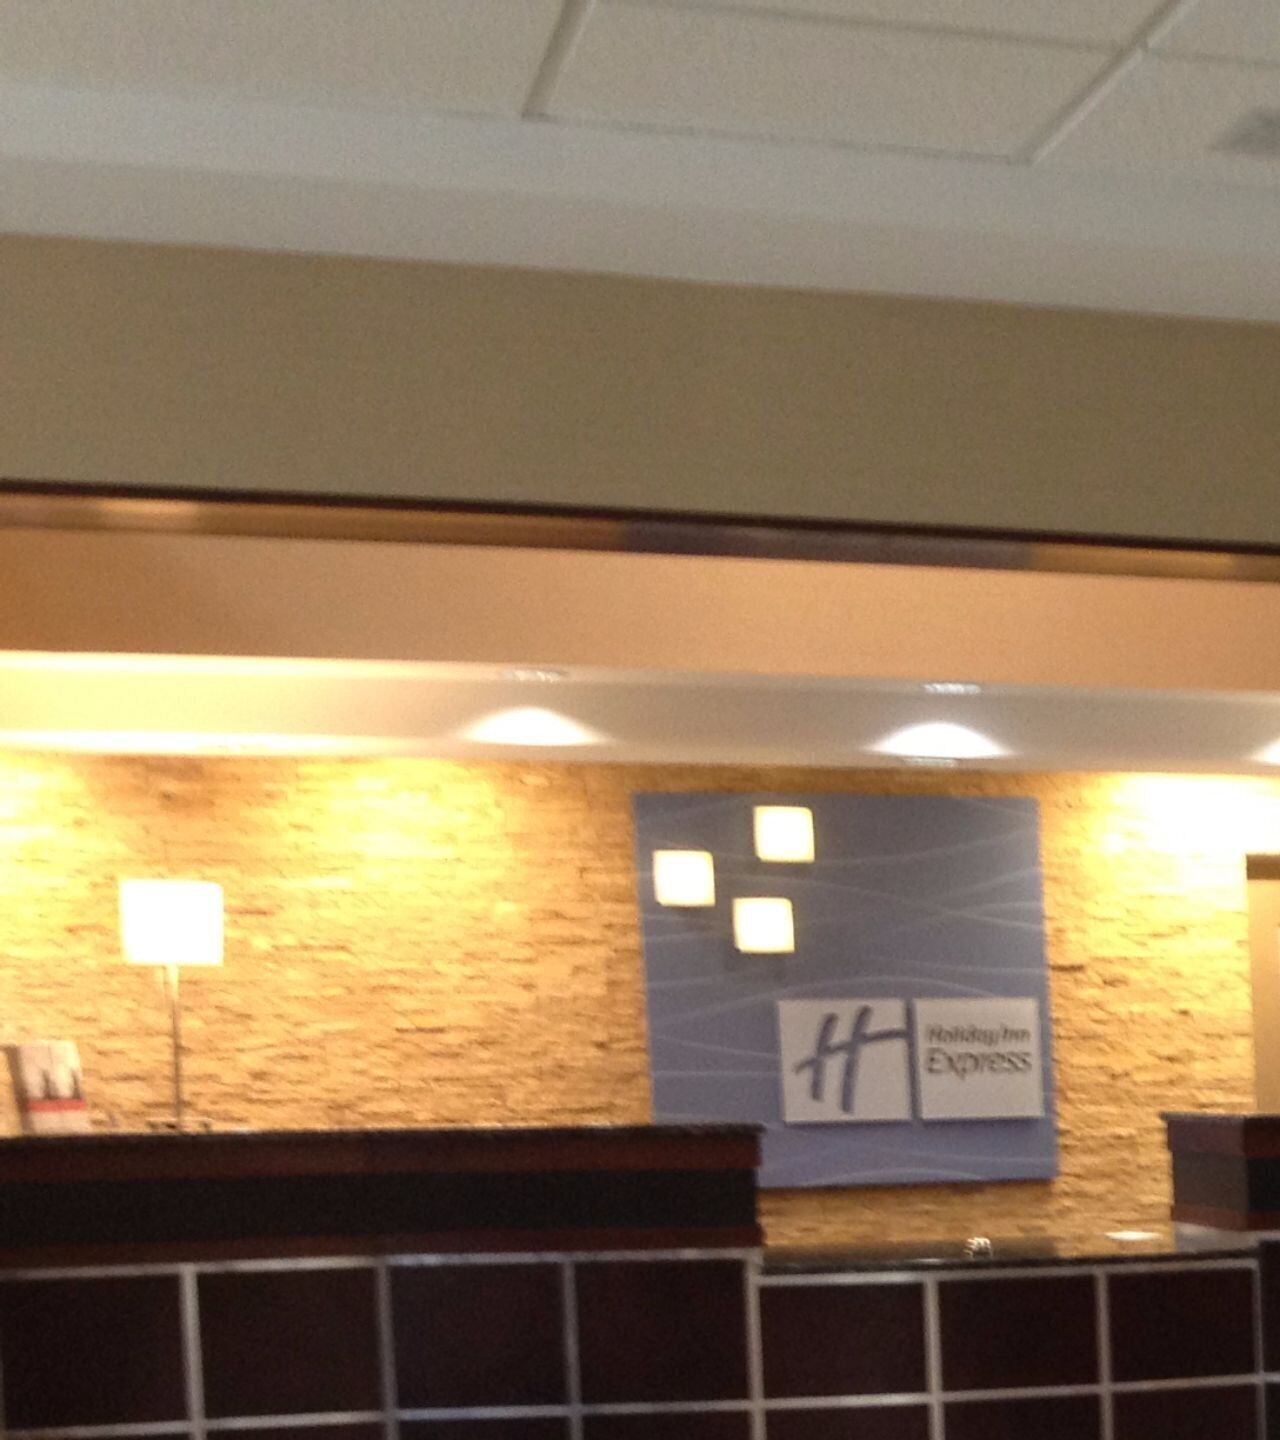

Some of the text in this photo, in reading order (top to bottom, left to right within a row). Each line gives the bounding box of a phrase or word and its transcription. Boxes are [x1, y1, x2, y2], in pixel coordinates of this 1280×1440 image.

[928, 1023, 1031, 1046] Holiday Inn
[926, 1047, 1032, 1082] Express
